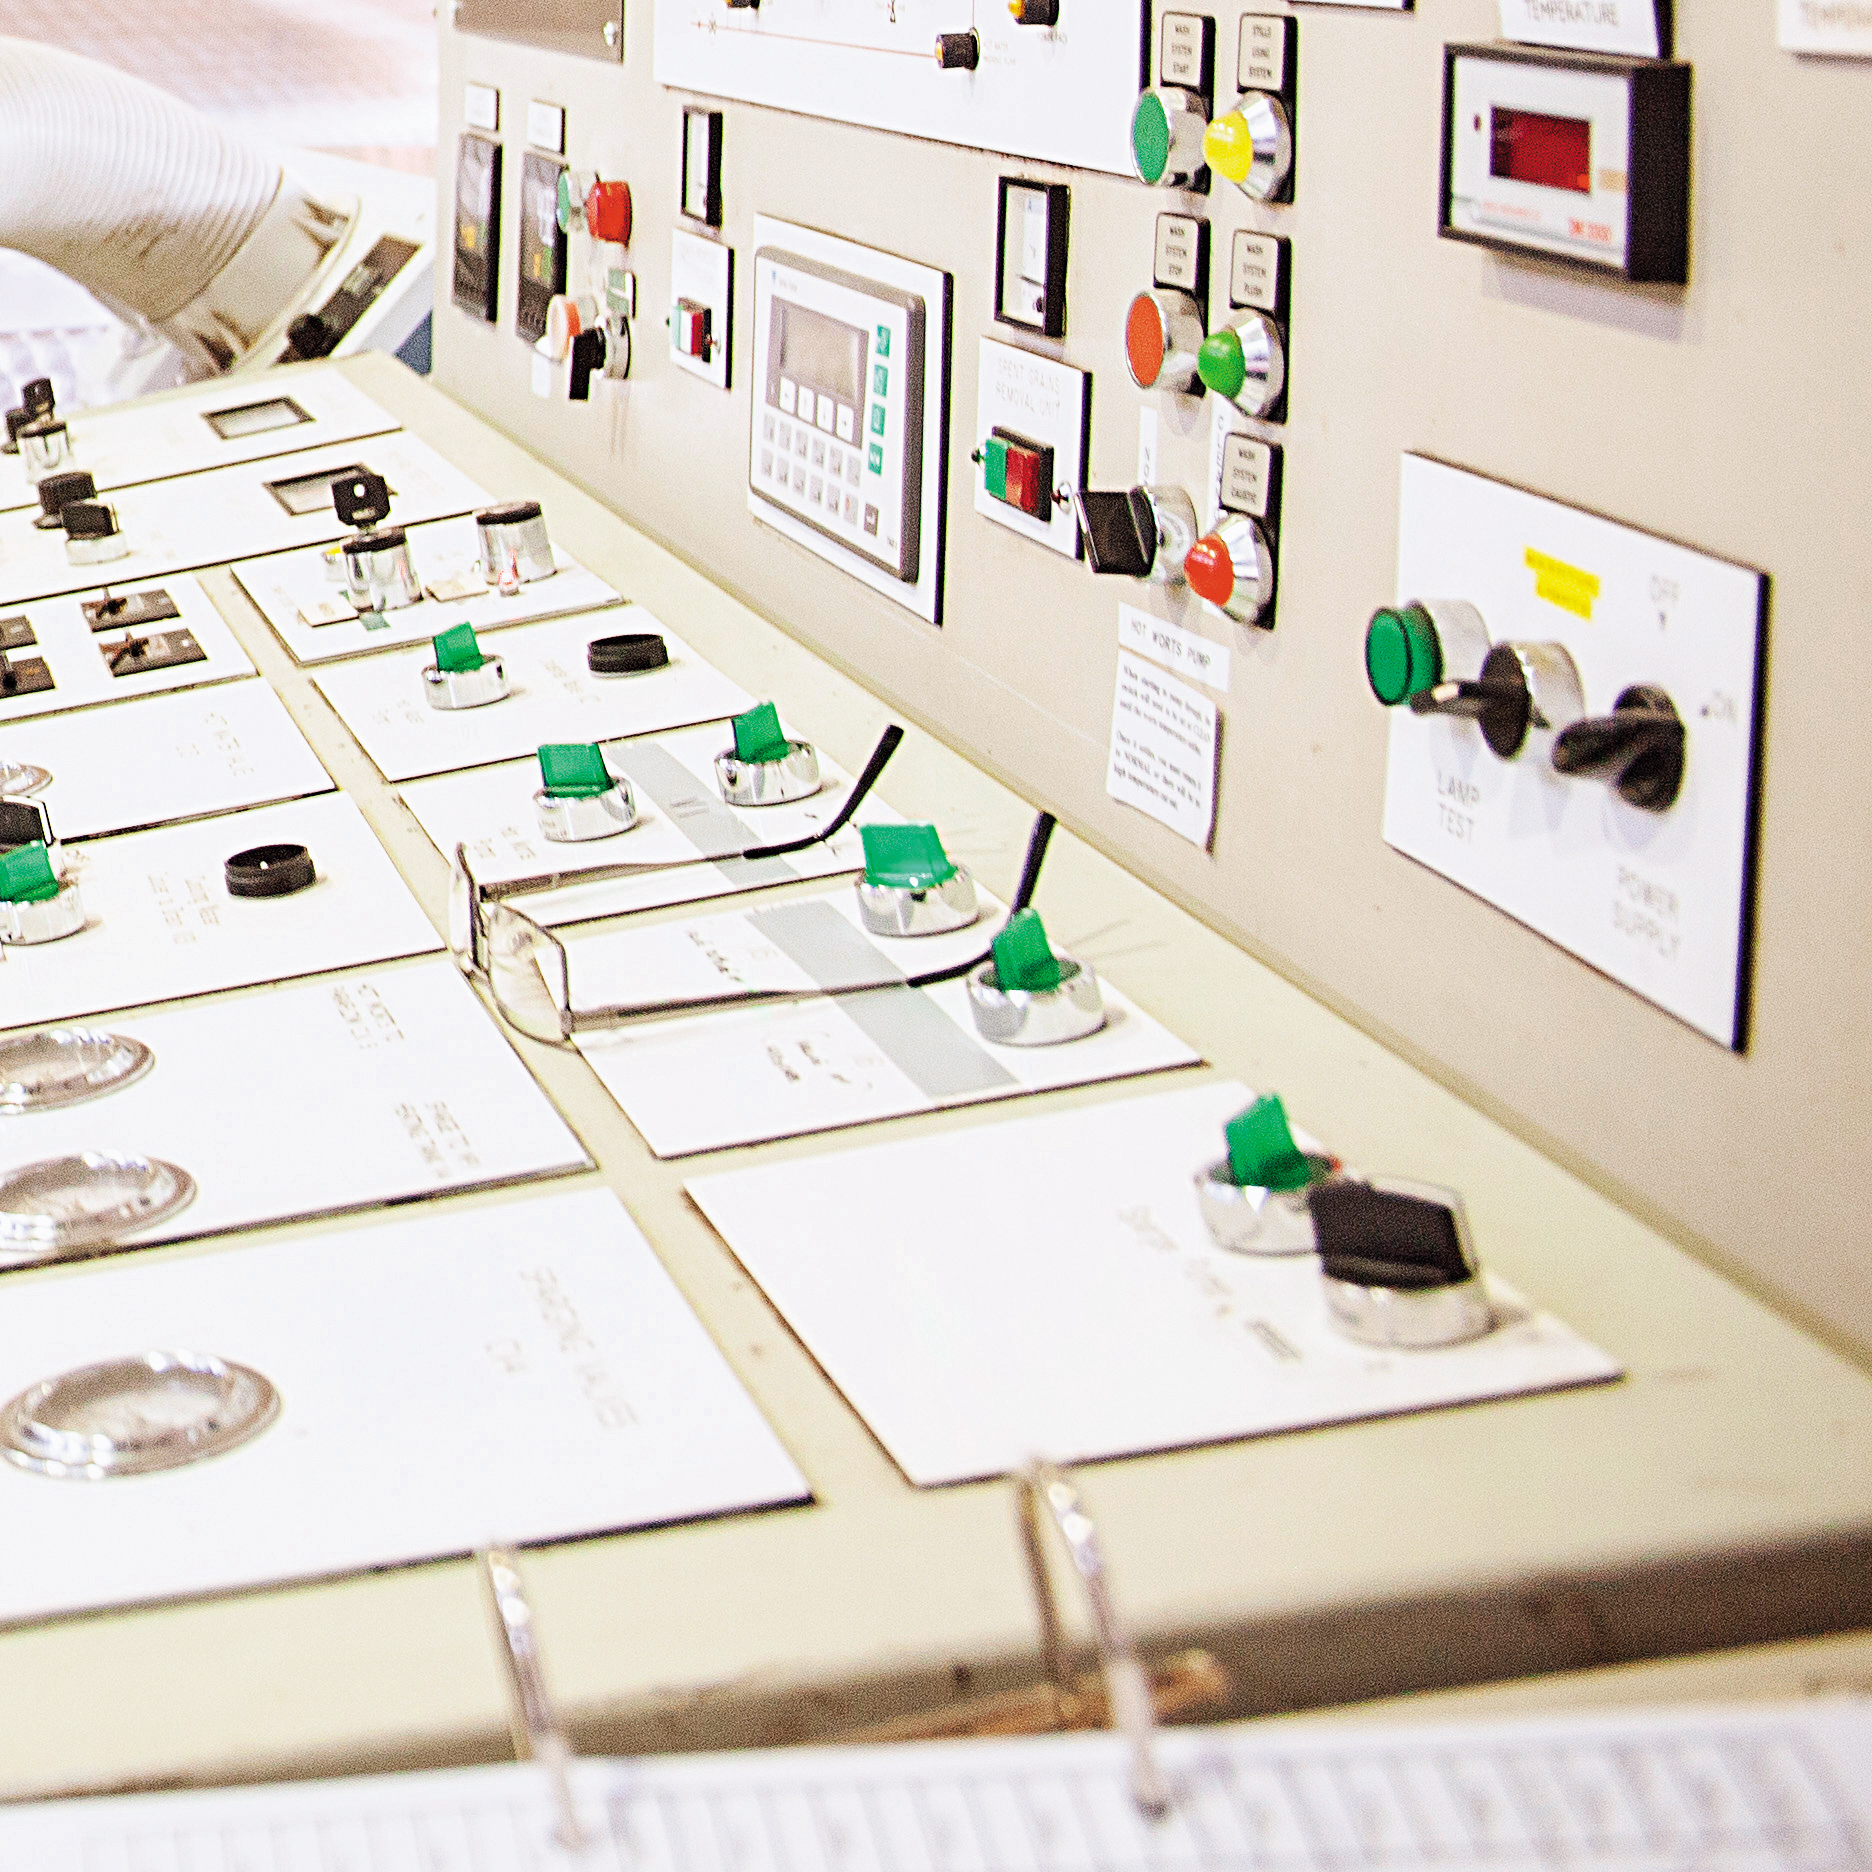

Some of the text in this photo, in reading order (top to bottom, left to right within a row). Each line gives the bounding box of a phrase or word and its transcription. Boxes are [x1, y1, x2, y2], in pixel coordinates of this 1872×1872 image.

[995, 380, 1036, 413] REMOVAL
[1028, 367, 1060, 396] GRAINS
[1650, 573, 1681, 608] OFF
[1131, 617, 1211, 670] HOT WORTS PUMP
[1437, 768, 1481, 806] LAMP
[1437, 802, 1476, 843] TEST
[1617, 864, 1681, 923] POWER
[1613, 897, 1681, 961] SUPPLY
